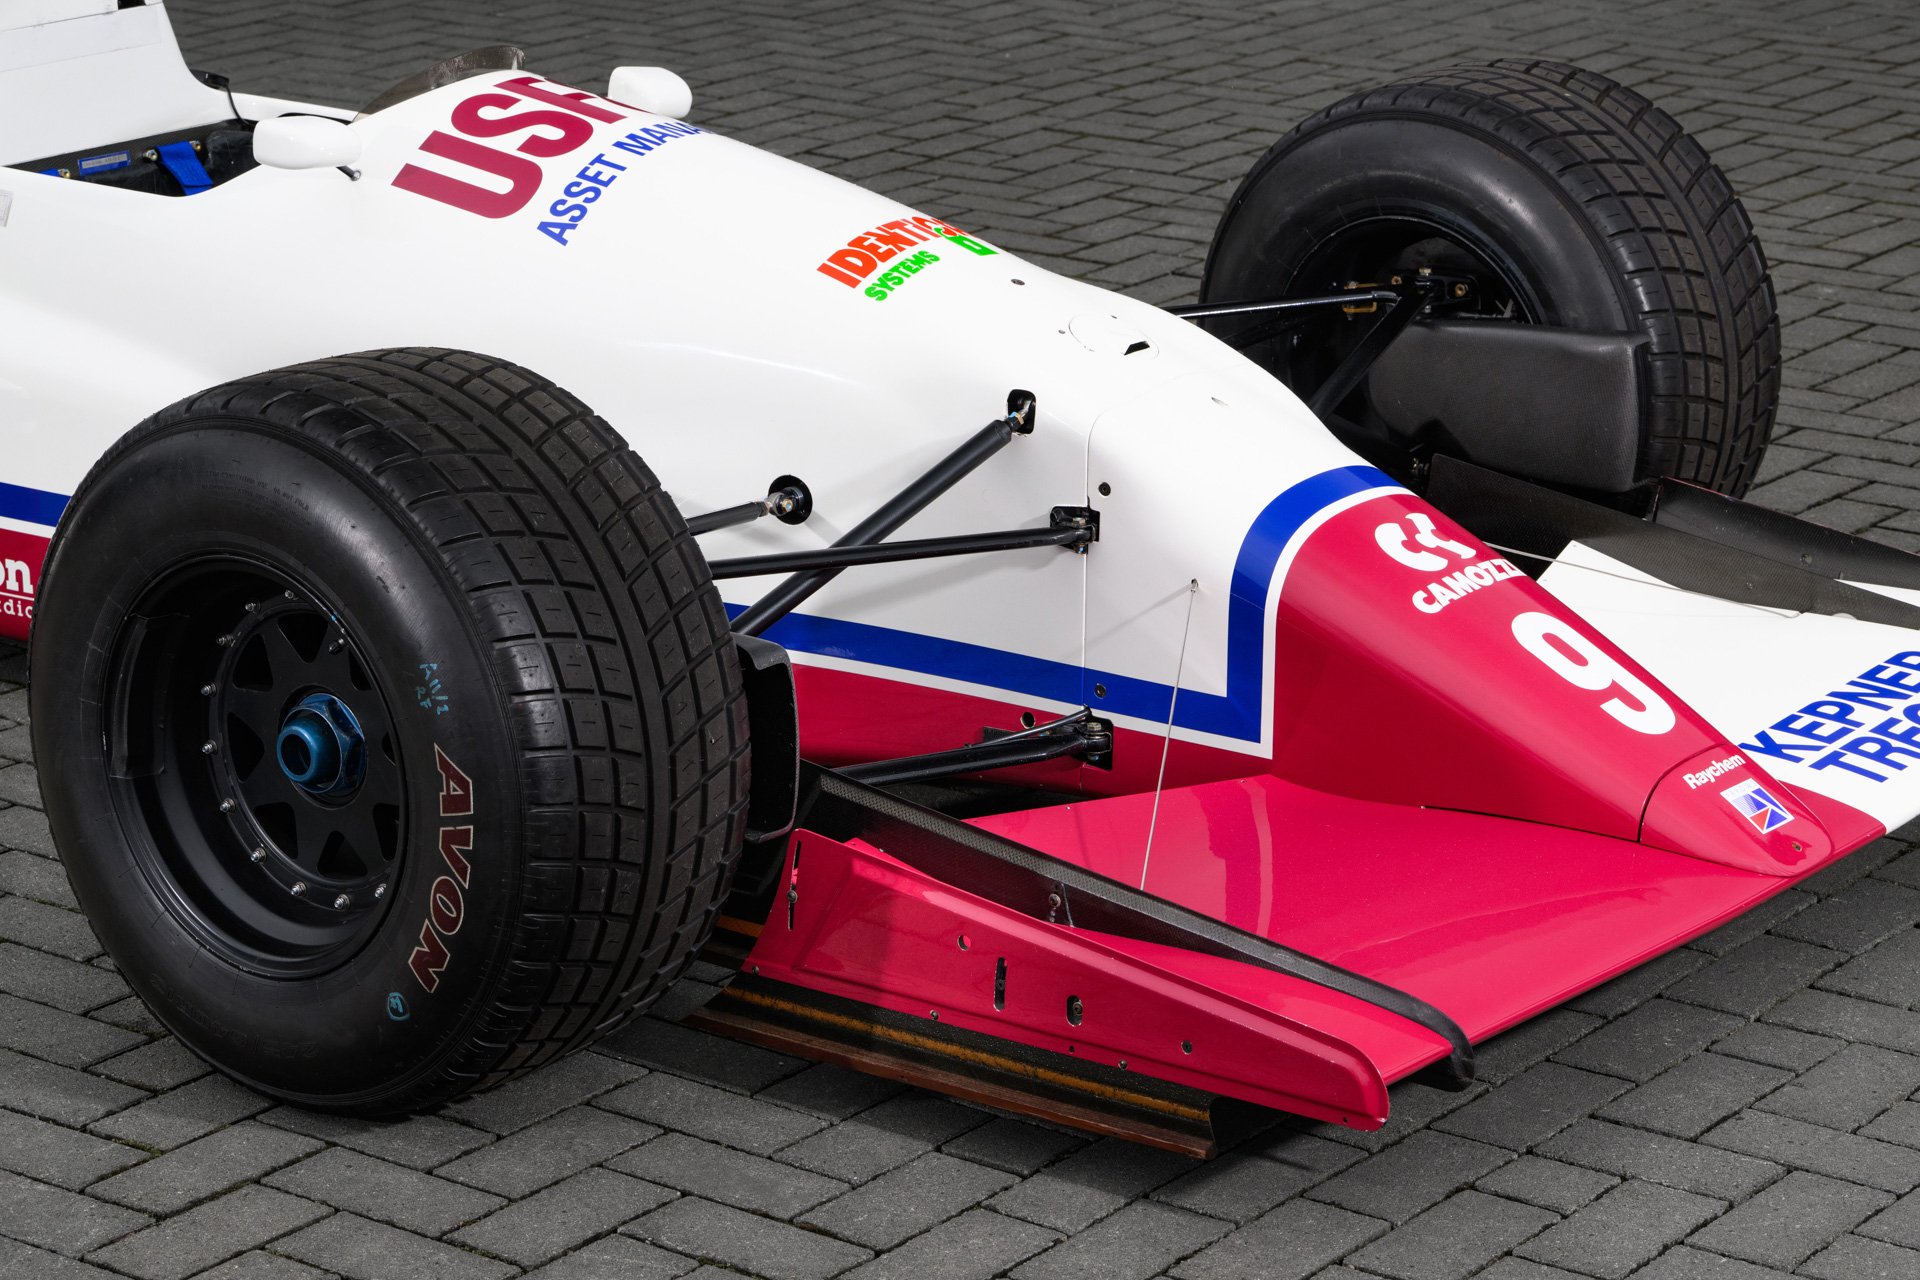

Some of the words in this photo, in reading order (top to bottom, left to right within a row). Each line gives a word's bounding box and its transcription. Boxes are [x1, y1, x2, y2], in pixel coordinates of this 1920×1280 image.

[537, 153, 627, 247] ASSET
[864, 250, 941, 301] SYSTEMS
[1511, 611, 1677, 735] 9
[1682, 754, 1747, 790] Raychem
[408, 742, 475, 994] AVON
